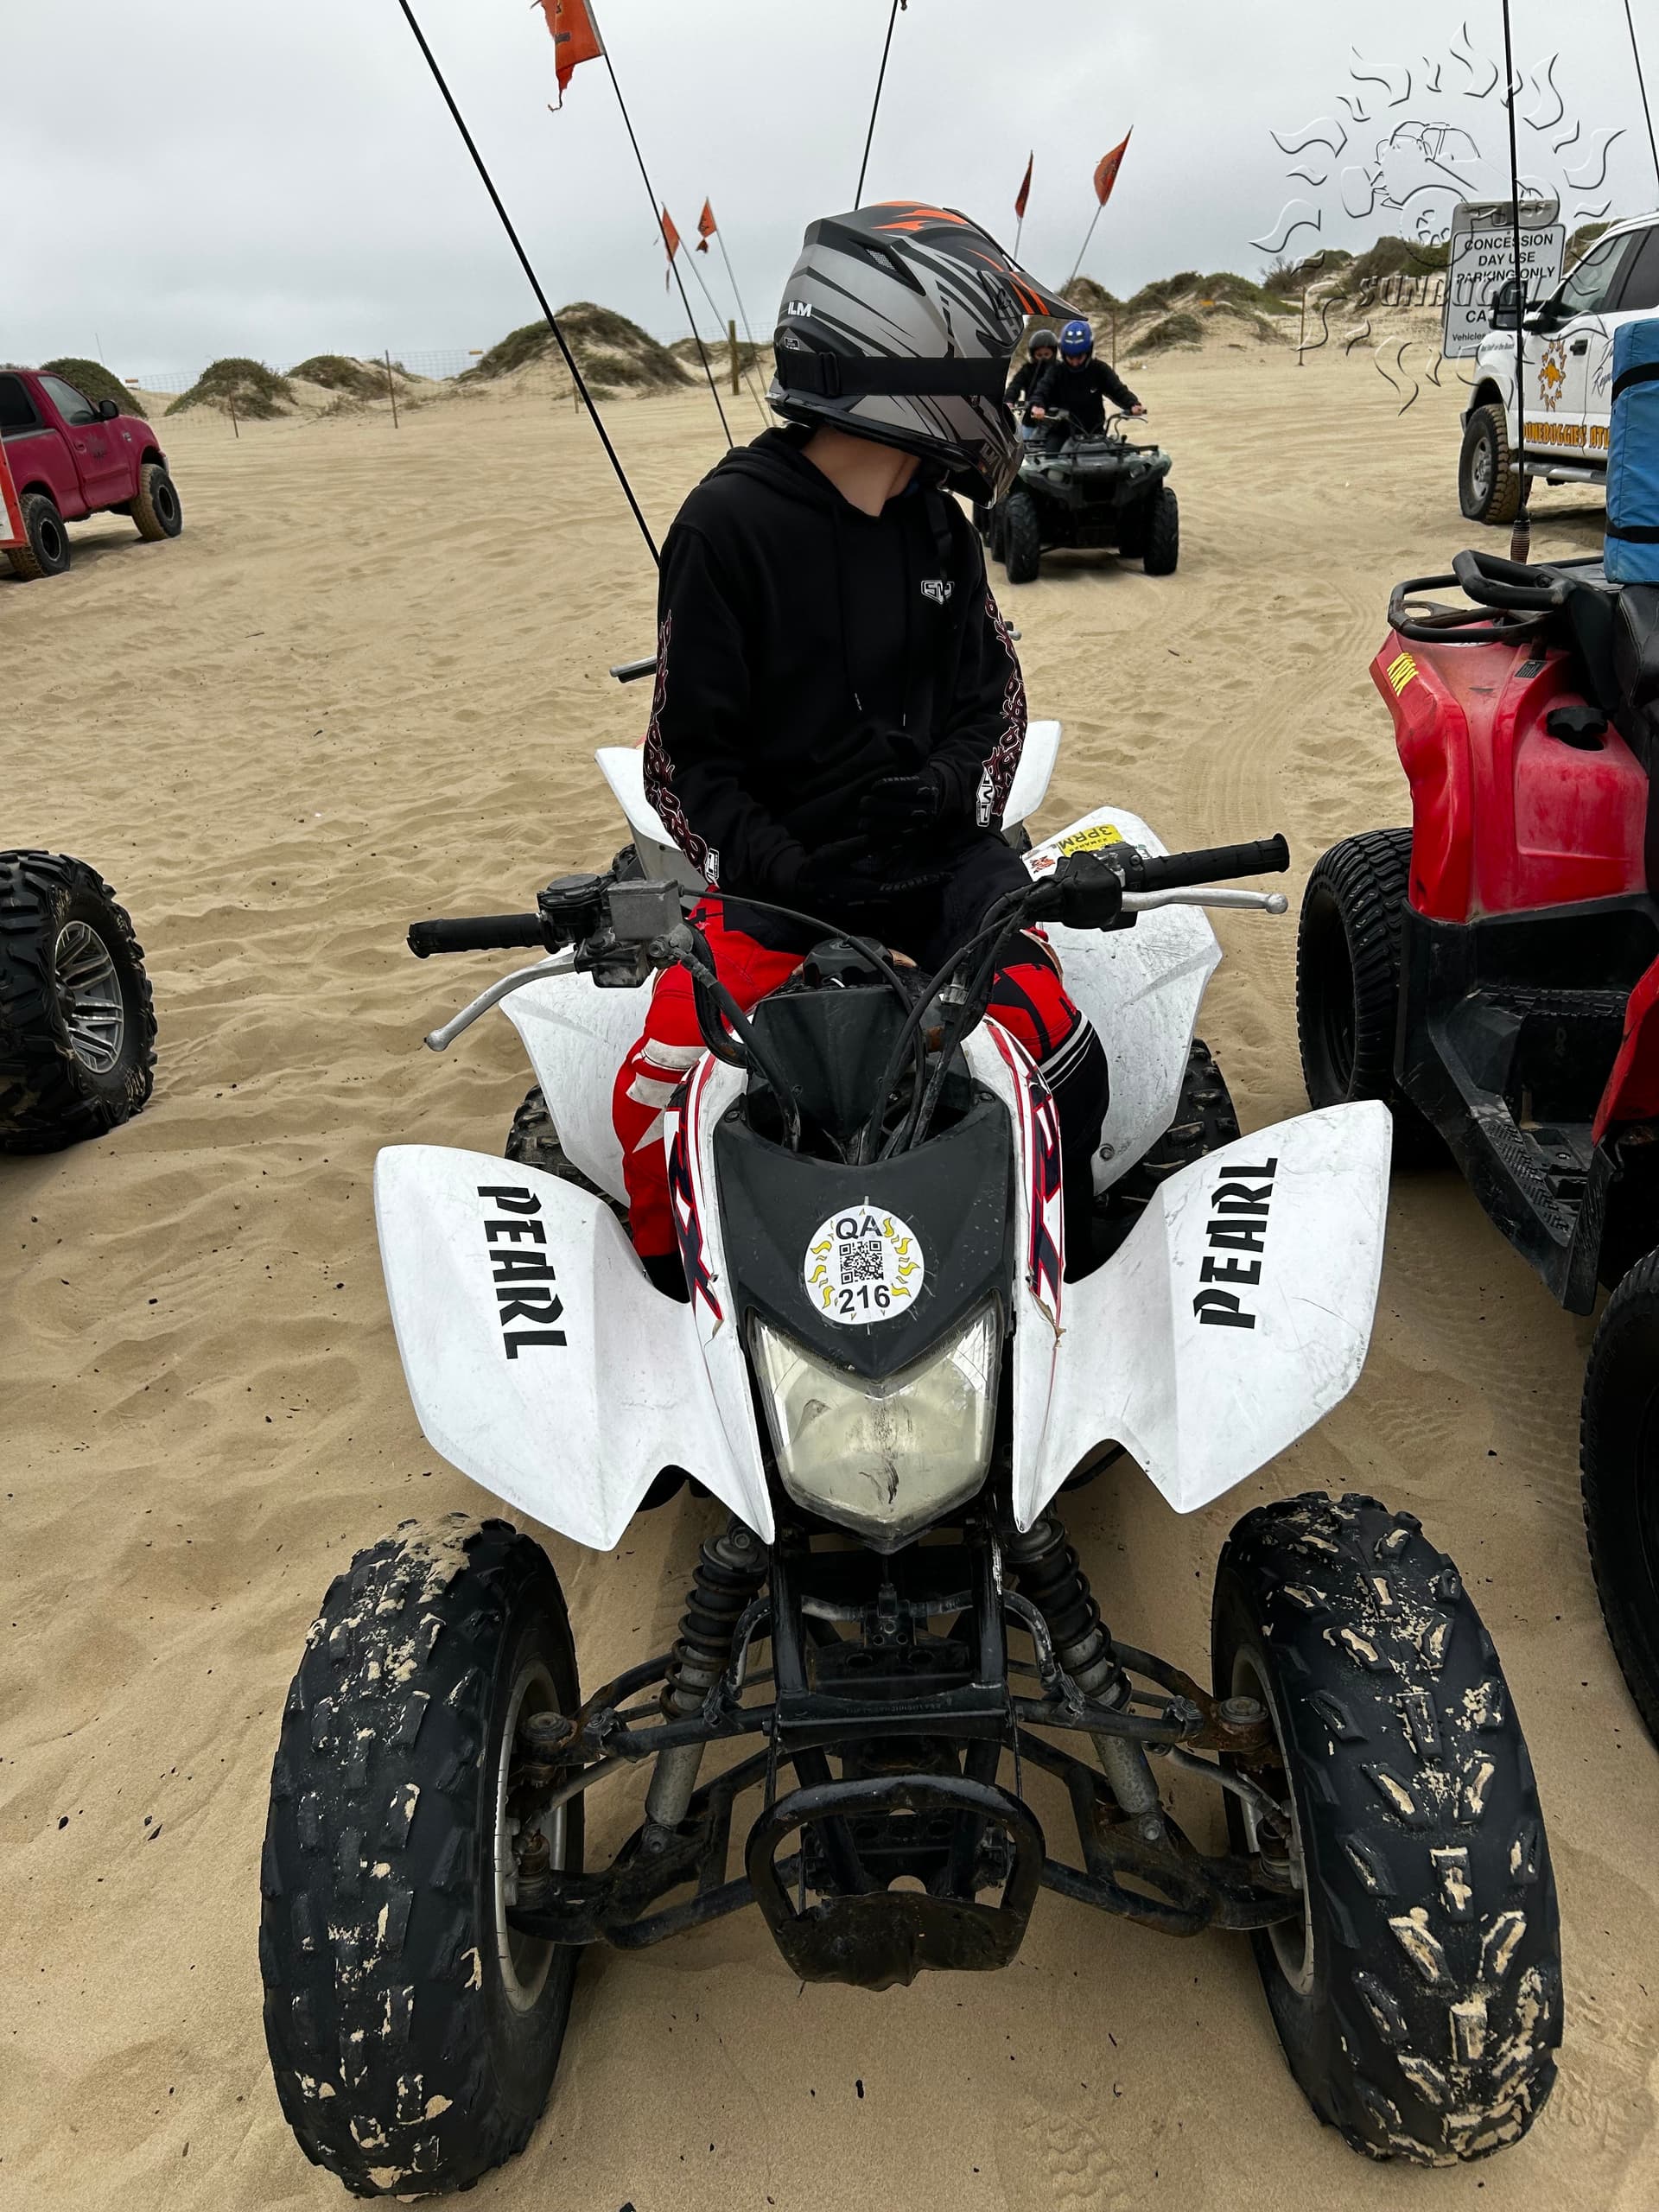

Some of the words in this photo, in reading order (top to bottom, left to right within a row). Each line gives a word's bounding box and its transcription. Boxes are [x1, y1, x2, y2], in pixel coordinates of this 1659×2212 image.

[1478, 254, 1505, 267] DAY
[1457, 270, 1516, 284] PARKING
[1520, 266, 1555, 279] ONLY
[787, 302, 812, 317] ILM
[836, 1215, 883, 1240] QA
[1193, 1158, 1278, 1329] PEARL
[477, 1186, 567, 1359] PEARL
[838, 1285, 891, 1314] 216
